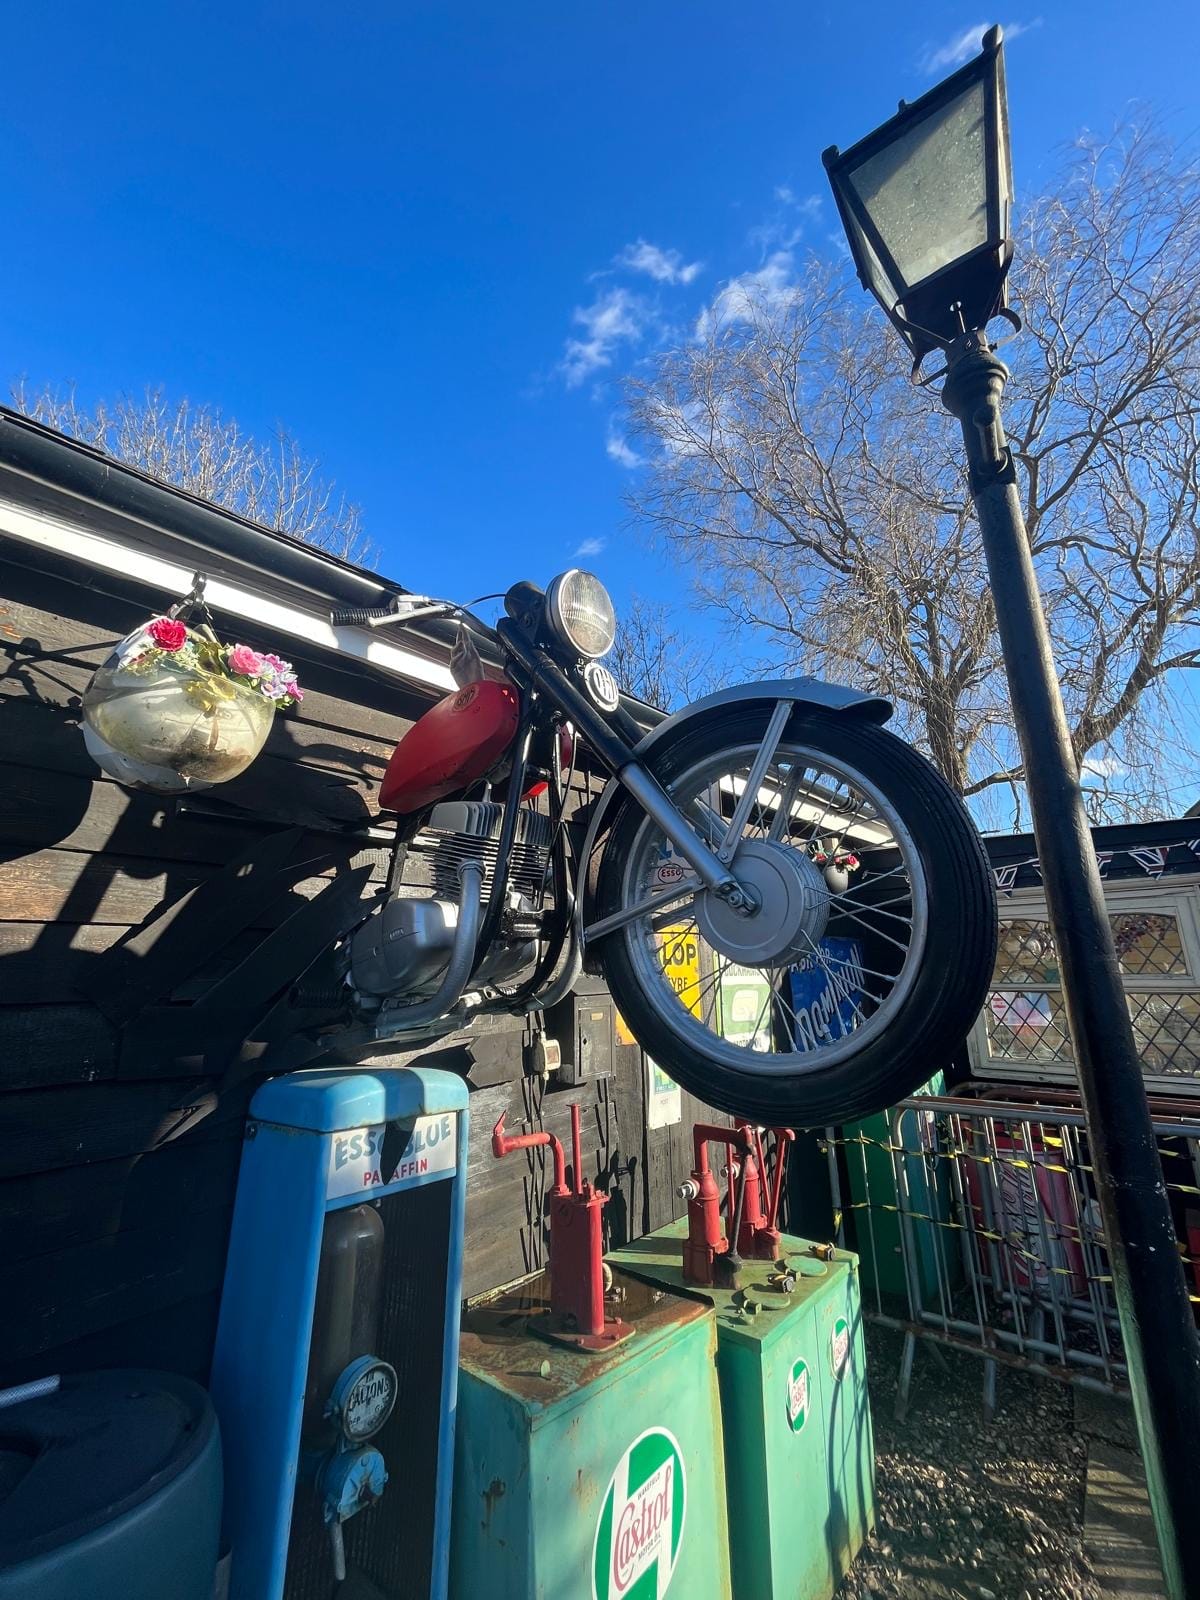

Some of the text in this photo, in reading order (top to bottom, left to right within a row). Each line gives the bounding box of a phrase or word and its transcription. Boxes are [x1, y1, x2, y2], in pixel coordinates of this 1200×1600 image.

[663, 942, 697, 966] LOP
[363, 1158, 429, 1186] PAAFFIN
[613, 1464, 672, 1592] Castrol
